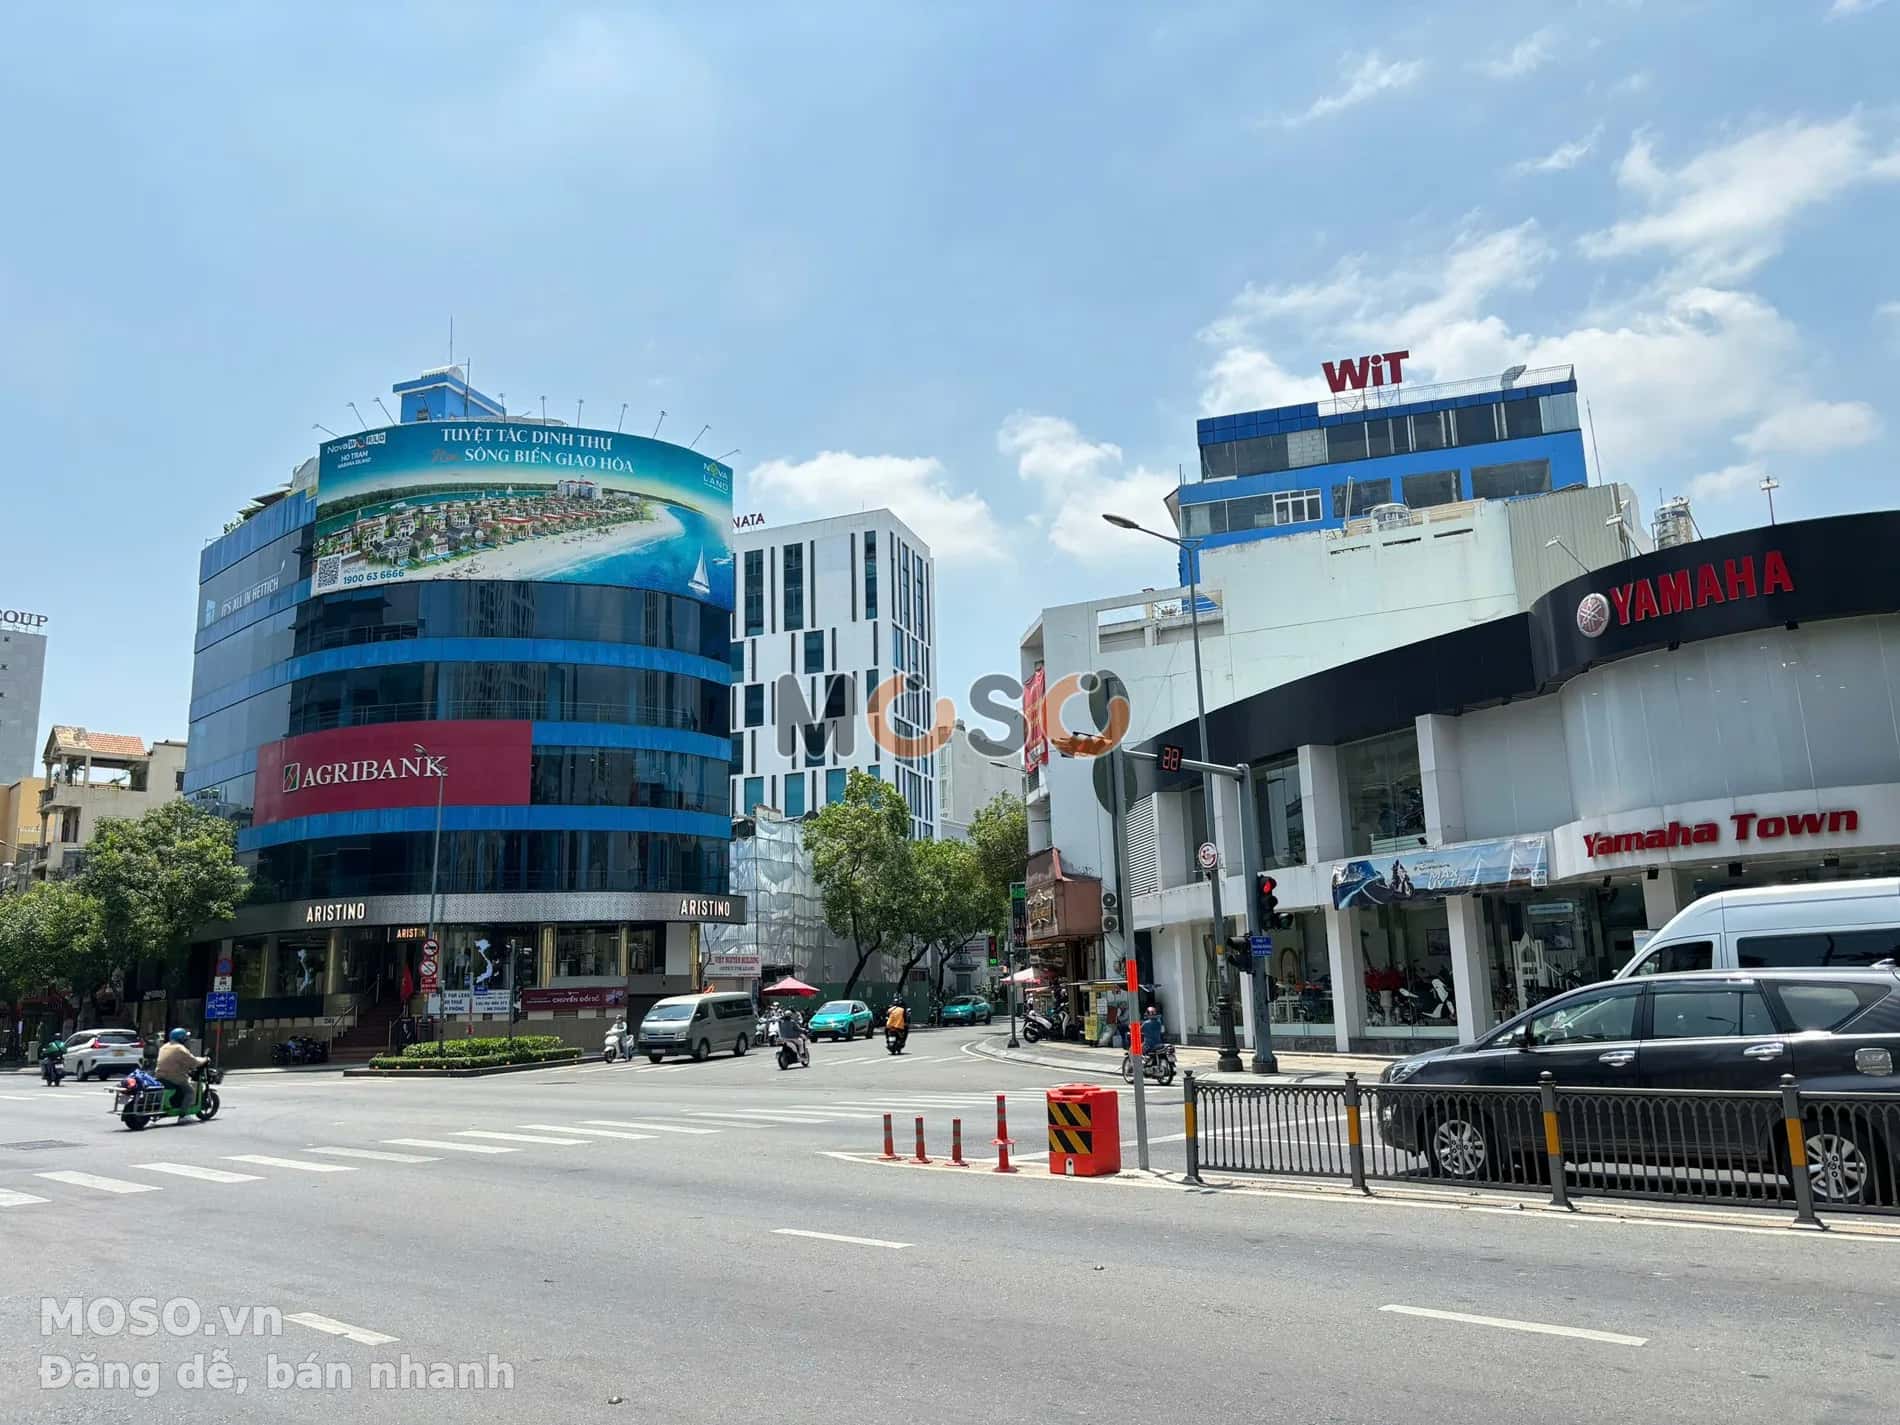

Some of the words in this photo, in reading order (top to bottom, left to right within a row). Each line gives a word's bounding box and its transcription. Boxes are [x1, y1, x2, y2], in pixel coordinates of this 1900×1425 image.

[441, 426, 493, 443] TUYỆT
[496, 427, 528, 443] TÁC
[532, 430, 573, 447] DINH
[577, 434, 612, 452] THỰ
[464, 446, 509, 463] SÔNG
[555, 453, 596, 468] GIAO
[600, 457, 634, 473] HÒA
[703, 474, 729, 491] LAND
[344, 574, 364, 585] 1900
[366, 572, 378, 581] 63
[380, 569, 405, 580] 6666
[1608, 550, 1795, 626] YAMAHA
[232, 595, 243, 612] ALL
[302, 755, 449, 789] AGRIBANK
[1583, 821, 1719, 858] Yamaha
[1730, 809, 1859, 841] Town
[306, 903, 366, 922] ARISTINO
[680, 899, 730, 917] ARISTINO
